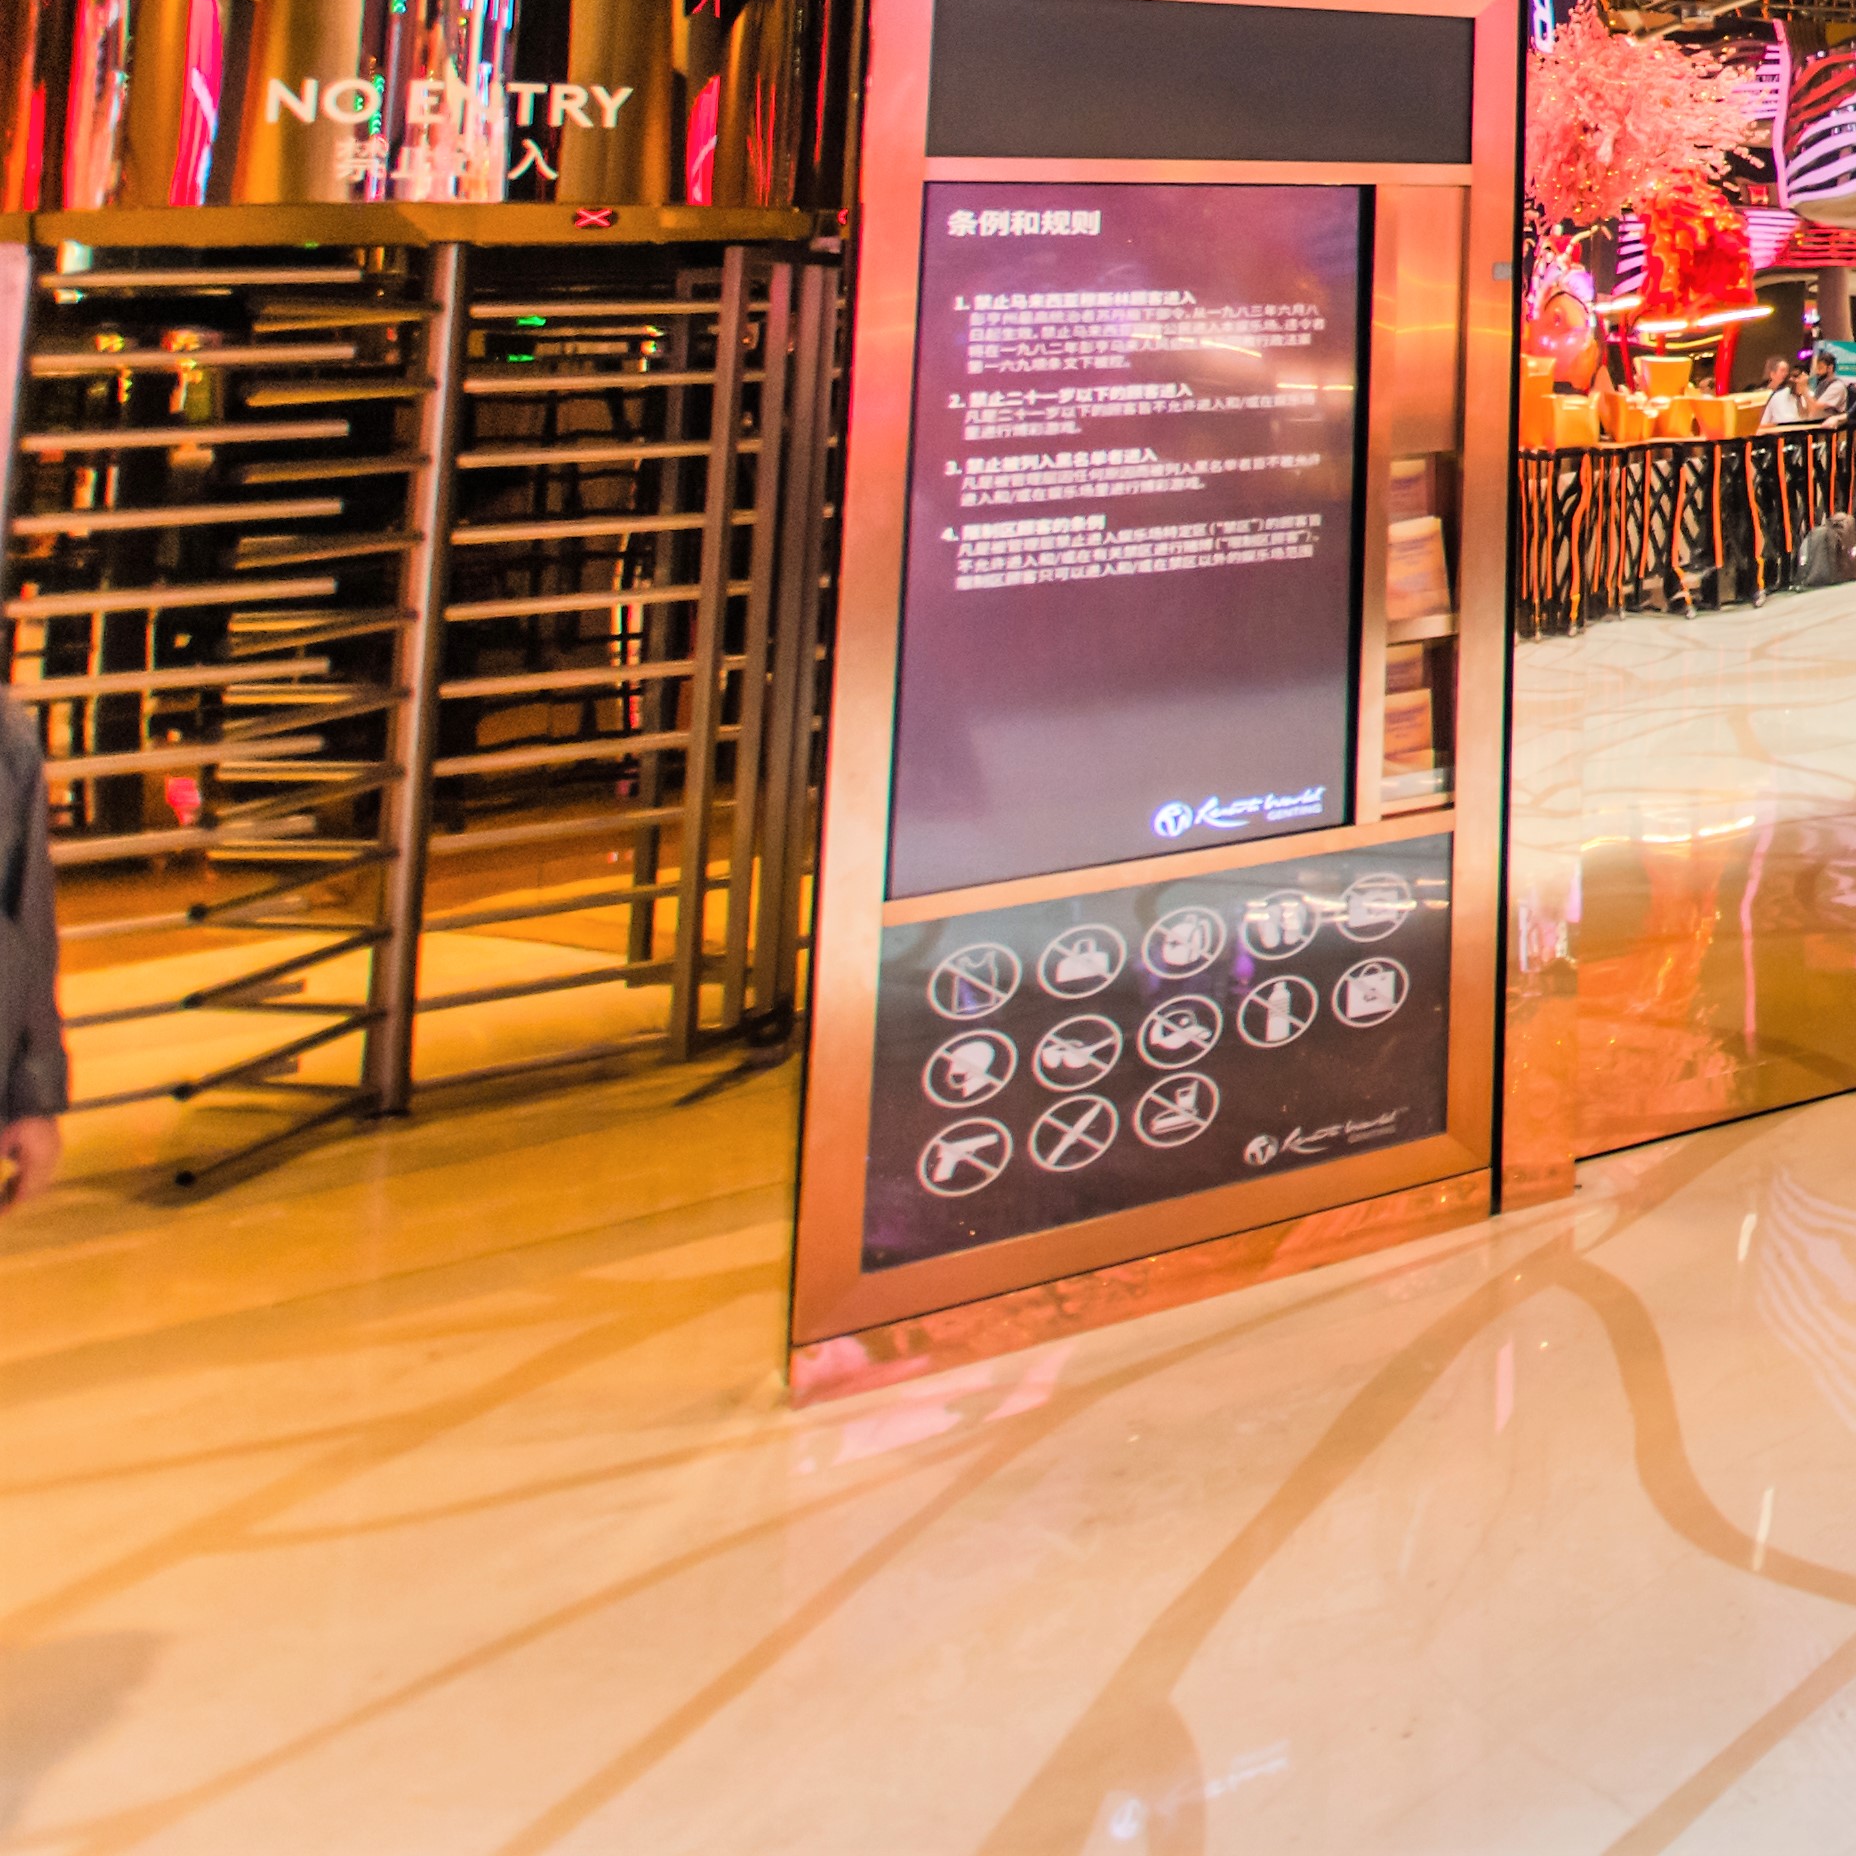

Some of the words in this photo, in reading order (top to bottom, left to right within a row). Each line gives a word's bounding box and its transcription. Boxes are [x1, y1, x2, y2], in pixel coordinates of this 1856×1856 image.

[265, 77, 384, 124] NO
[405, 80, 634, 128] ENTRY
[947, 209, 1101, 237] 条例和规则
